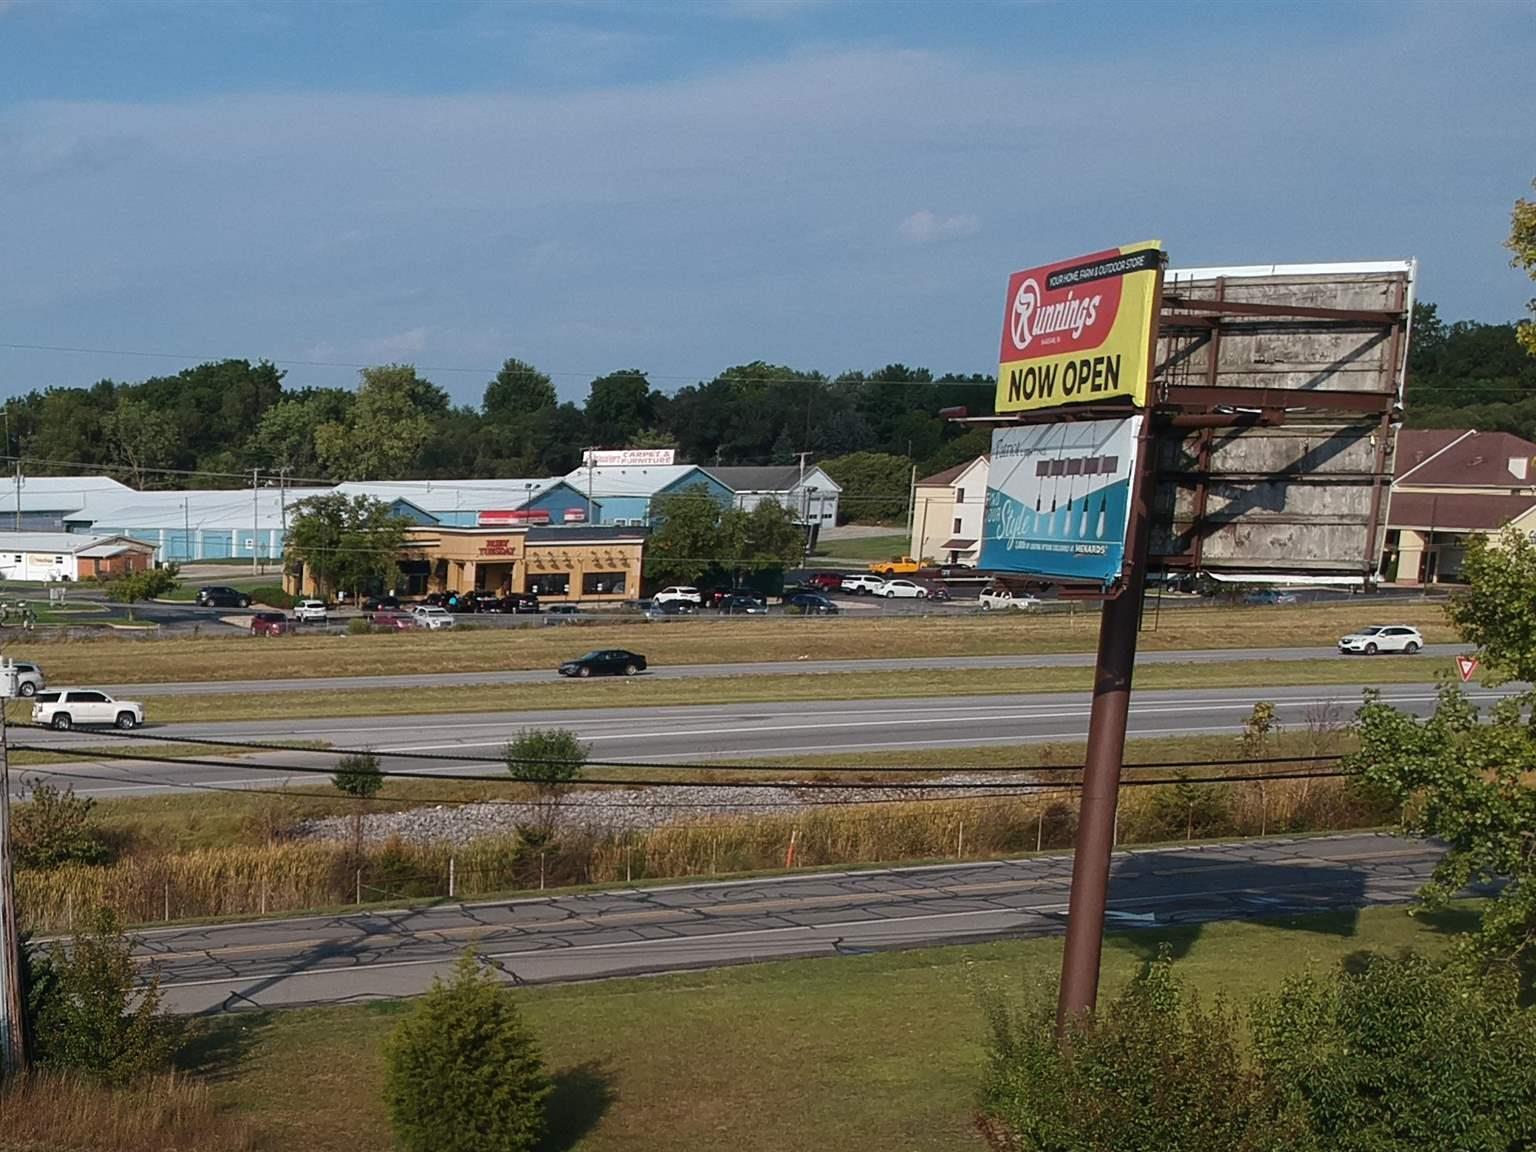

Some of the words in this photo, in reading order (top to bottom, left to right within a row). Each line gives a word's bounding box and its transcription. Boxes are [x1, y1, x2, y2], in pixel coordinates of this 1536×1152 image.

[1049, 274, 1064, 286] YOUR
[1079, 266, 1094, 278] FARM
[1098, 260, 1125, 276] OUTDOOR
[1125, 255, 1145, 269] STORE
[1008, 363, 1059, 402] NOW
[1062, 354, 1121, 397] OPEN
[996, 499, 1031, 551] Style
